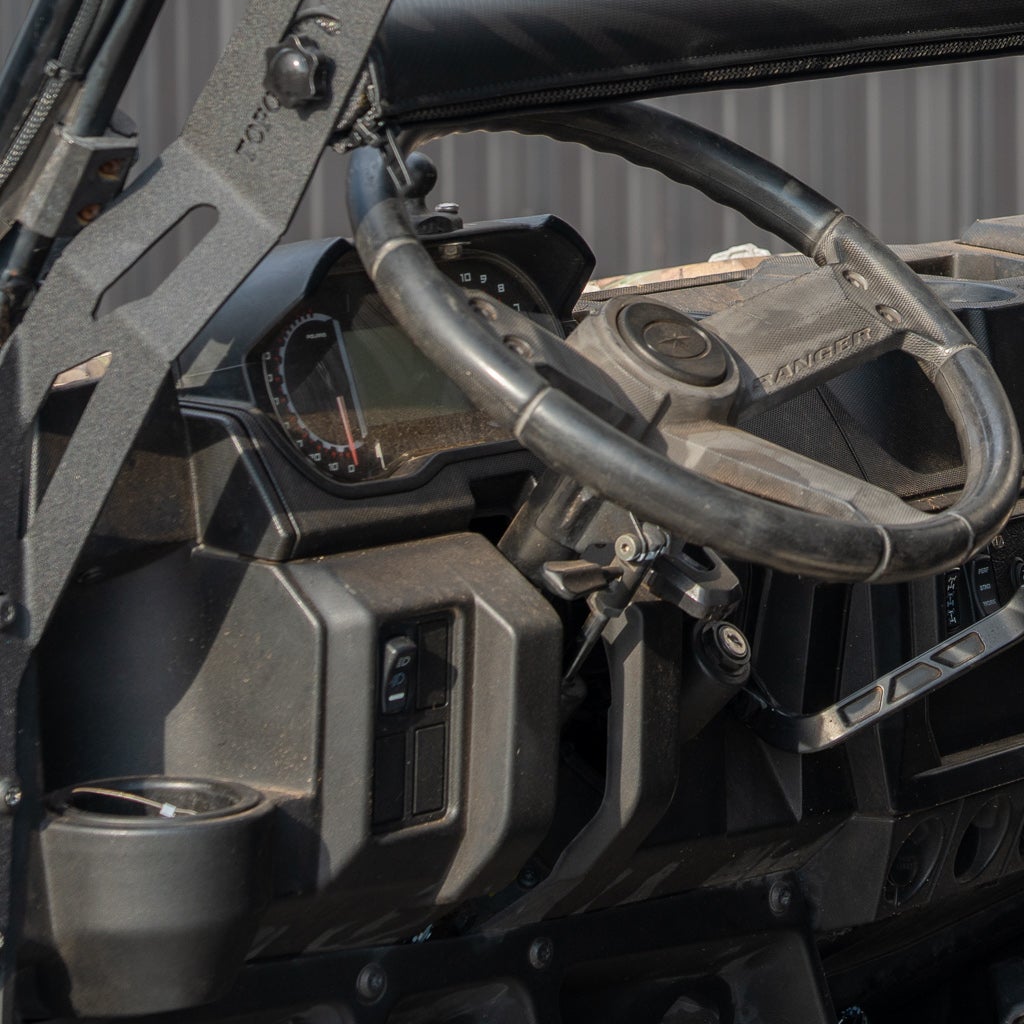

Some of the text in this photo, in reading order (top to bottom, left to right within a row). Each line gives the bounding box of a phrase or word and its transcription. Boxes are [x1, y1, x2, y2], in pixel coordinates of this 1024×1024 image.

[459, 272, 472, 283] 10
[479, 274, 488, 284] 9
[497, 283, 505, 293] 8
[754, 327, 872, 387] RANGER
